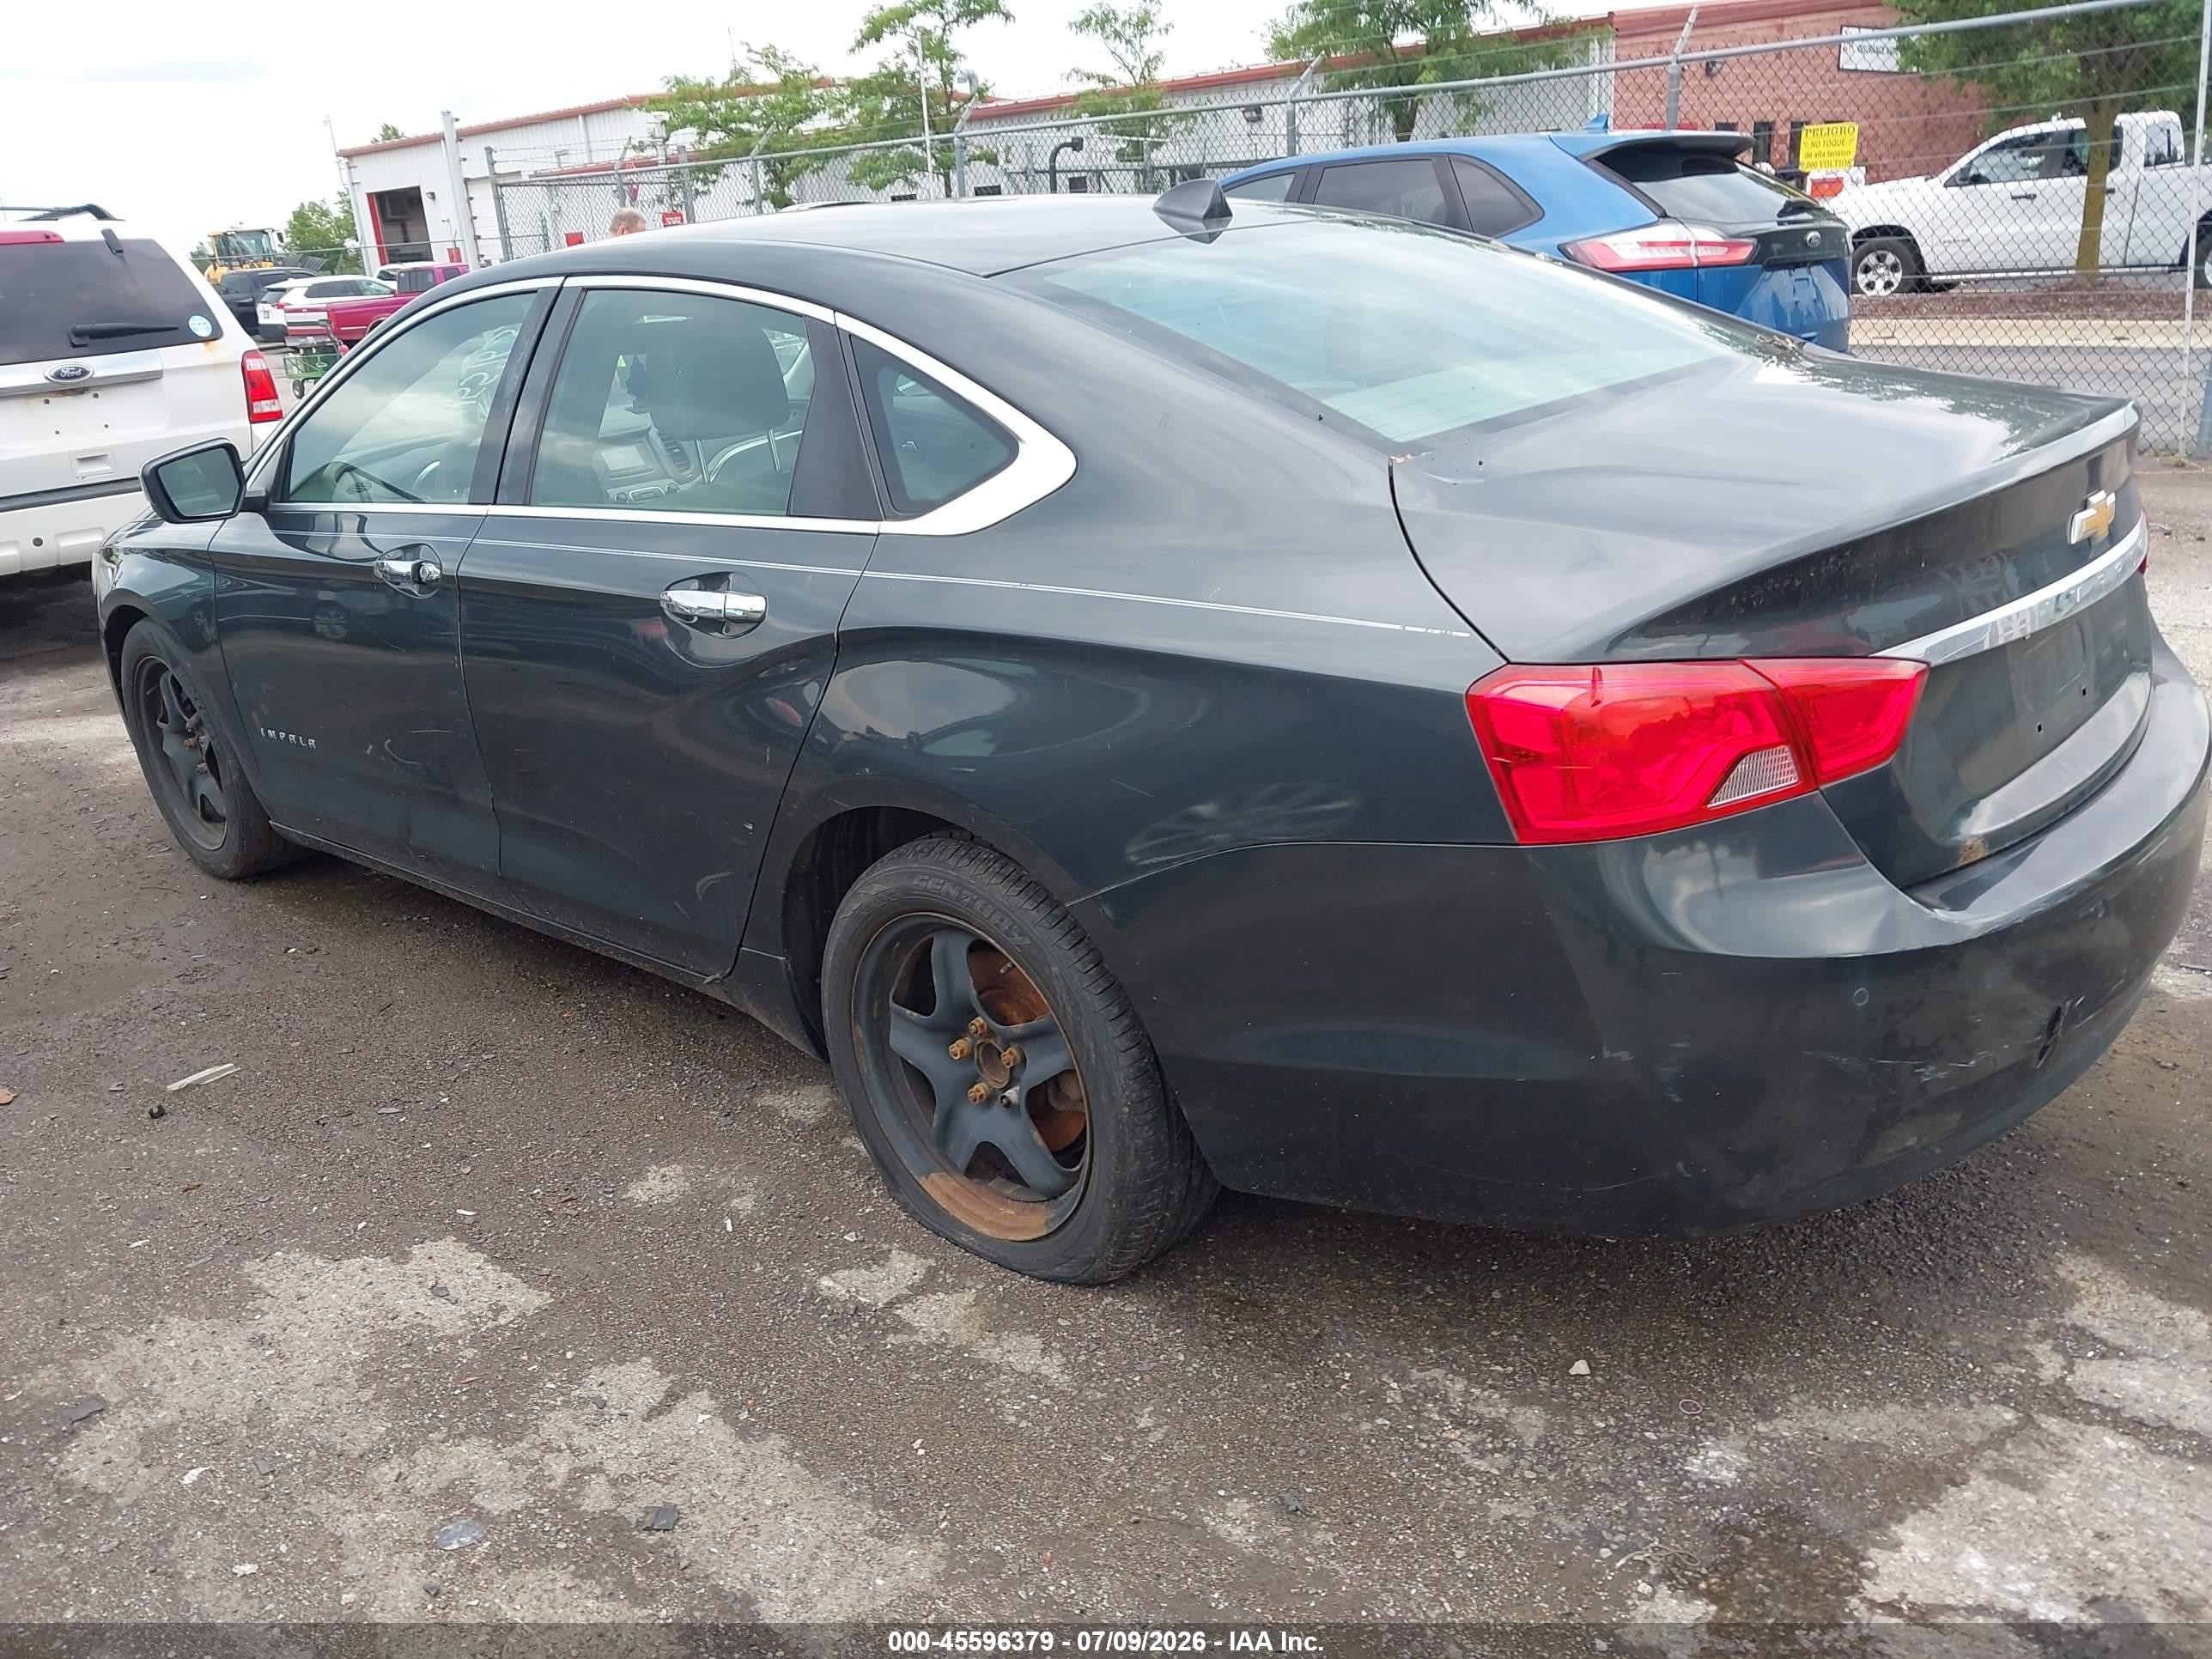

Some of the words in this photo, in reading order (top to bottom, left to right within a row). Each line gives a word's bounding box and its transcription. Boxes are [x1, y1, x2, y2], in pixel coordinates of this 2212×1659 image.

[1805, 126, 1855, 137] PELIGRO
[1810, 140, 1820, 149] NO
[1823, 139, 1844, 148] TOQUE
[1820, 159, 1851, 169] VOLTIOS
[60, 368, 82, 378] Ford
[260, 727, 317, 749] IMPALA
